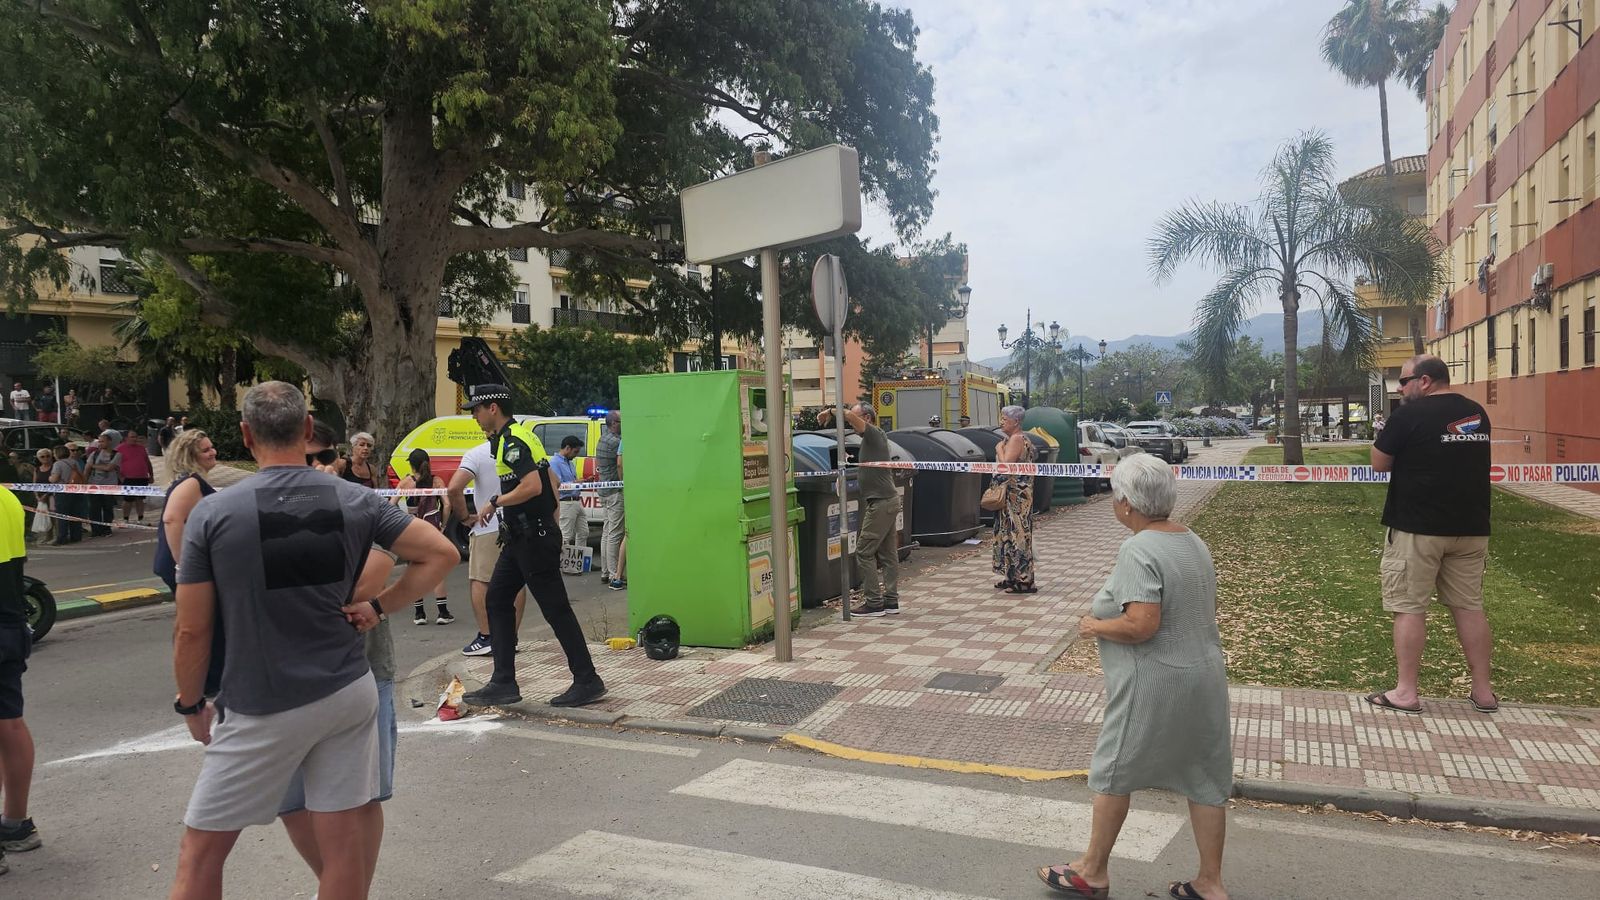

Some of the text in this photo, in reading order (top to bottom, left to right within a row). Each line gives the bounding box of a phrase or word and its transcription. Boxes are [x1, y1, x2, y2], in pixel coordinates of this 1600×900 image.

[1441, 433, 1489, 442] HONDA
[1009, 464, 1086, 476] NO PASAR POLICIA LOCAL
[1181, 466, 1211, 480] POLICIA
[1213, 466, 1239, 480] LOCAL
[1261, 466, 1289, 474] LINEA DE
[1311, 466, 1388, 481] NO PASAR POLICIA
[1508, 465, 1600, 482] NO PASAR POLICIA
[1258, 473, 1293, 481] SEGURIDAD
[564, 547, 584, 560] MYL
